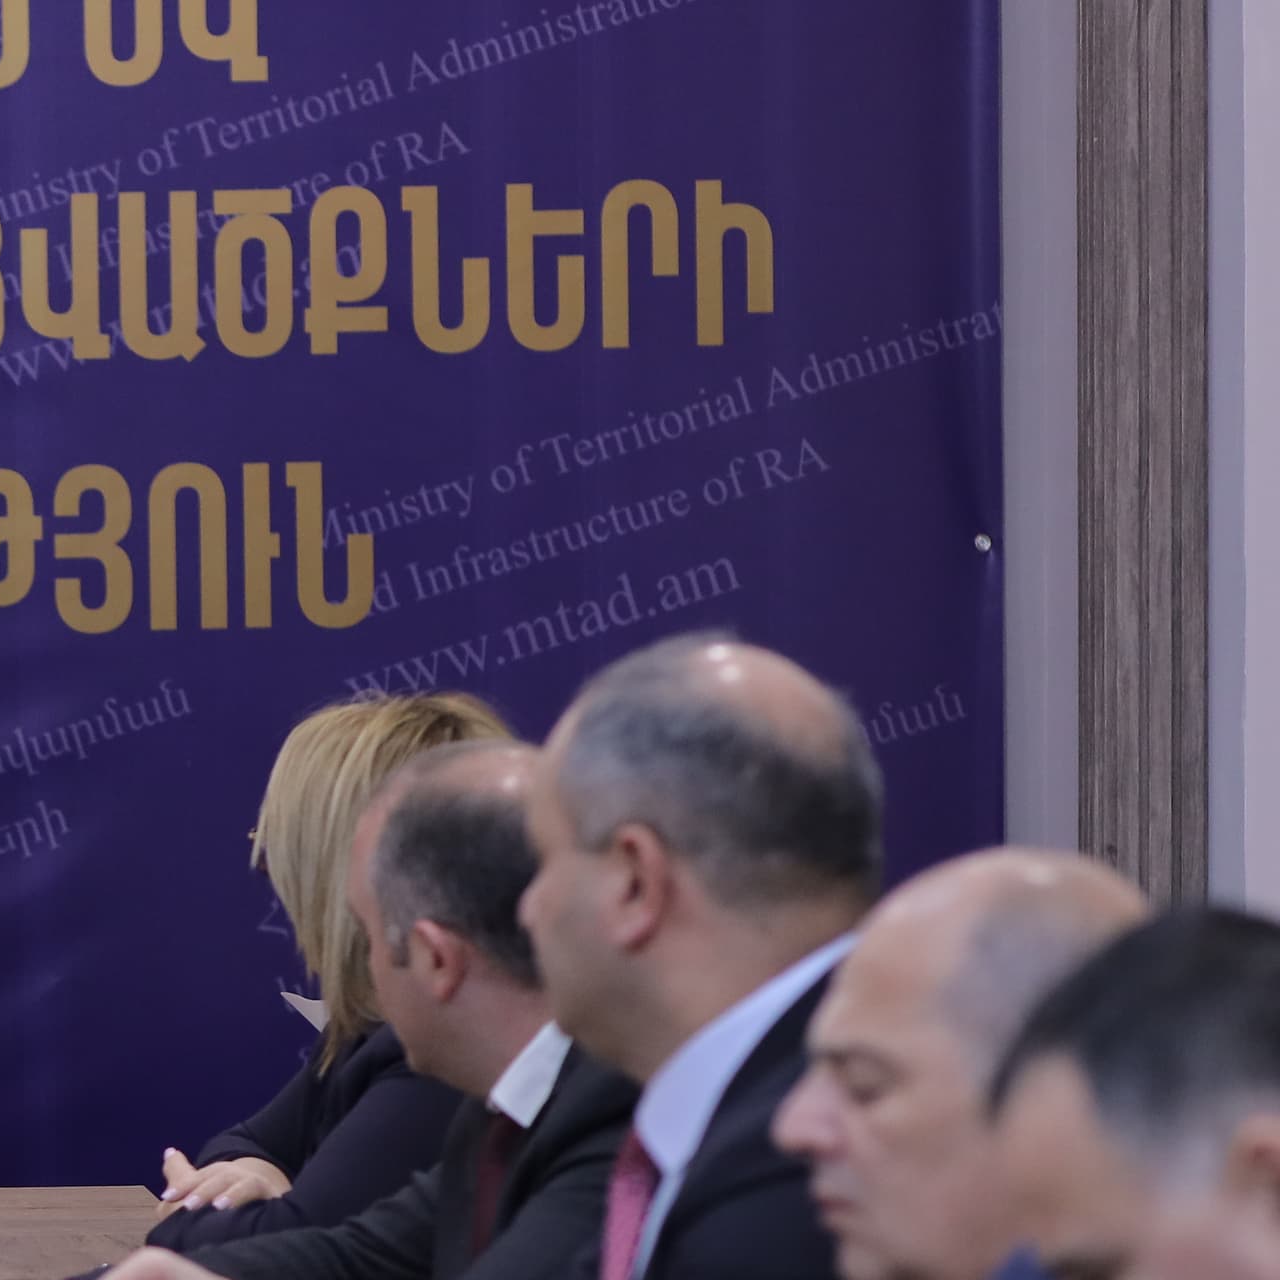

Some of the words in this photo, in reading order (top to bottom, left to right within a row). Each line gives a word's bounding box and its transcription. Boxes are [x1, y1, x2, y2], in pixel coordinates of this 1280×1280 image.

[136, 128, 181, 178] of
[185, 62, 397, 157] Territorial
[395, 120, 472, 173] RA
[489, 441, 536, 494] of
[539, 376, 753, 475] Territorial
[406, 482, 692, 602] Infrastructure
[702, 457, 746, 507] of
[755, 436, 832, 490] RA
